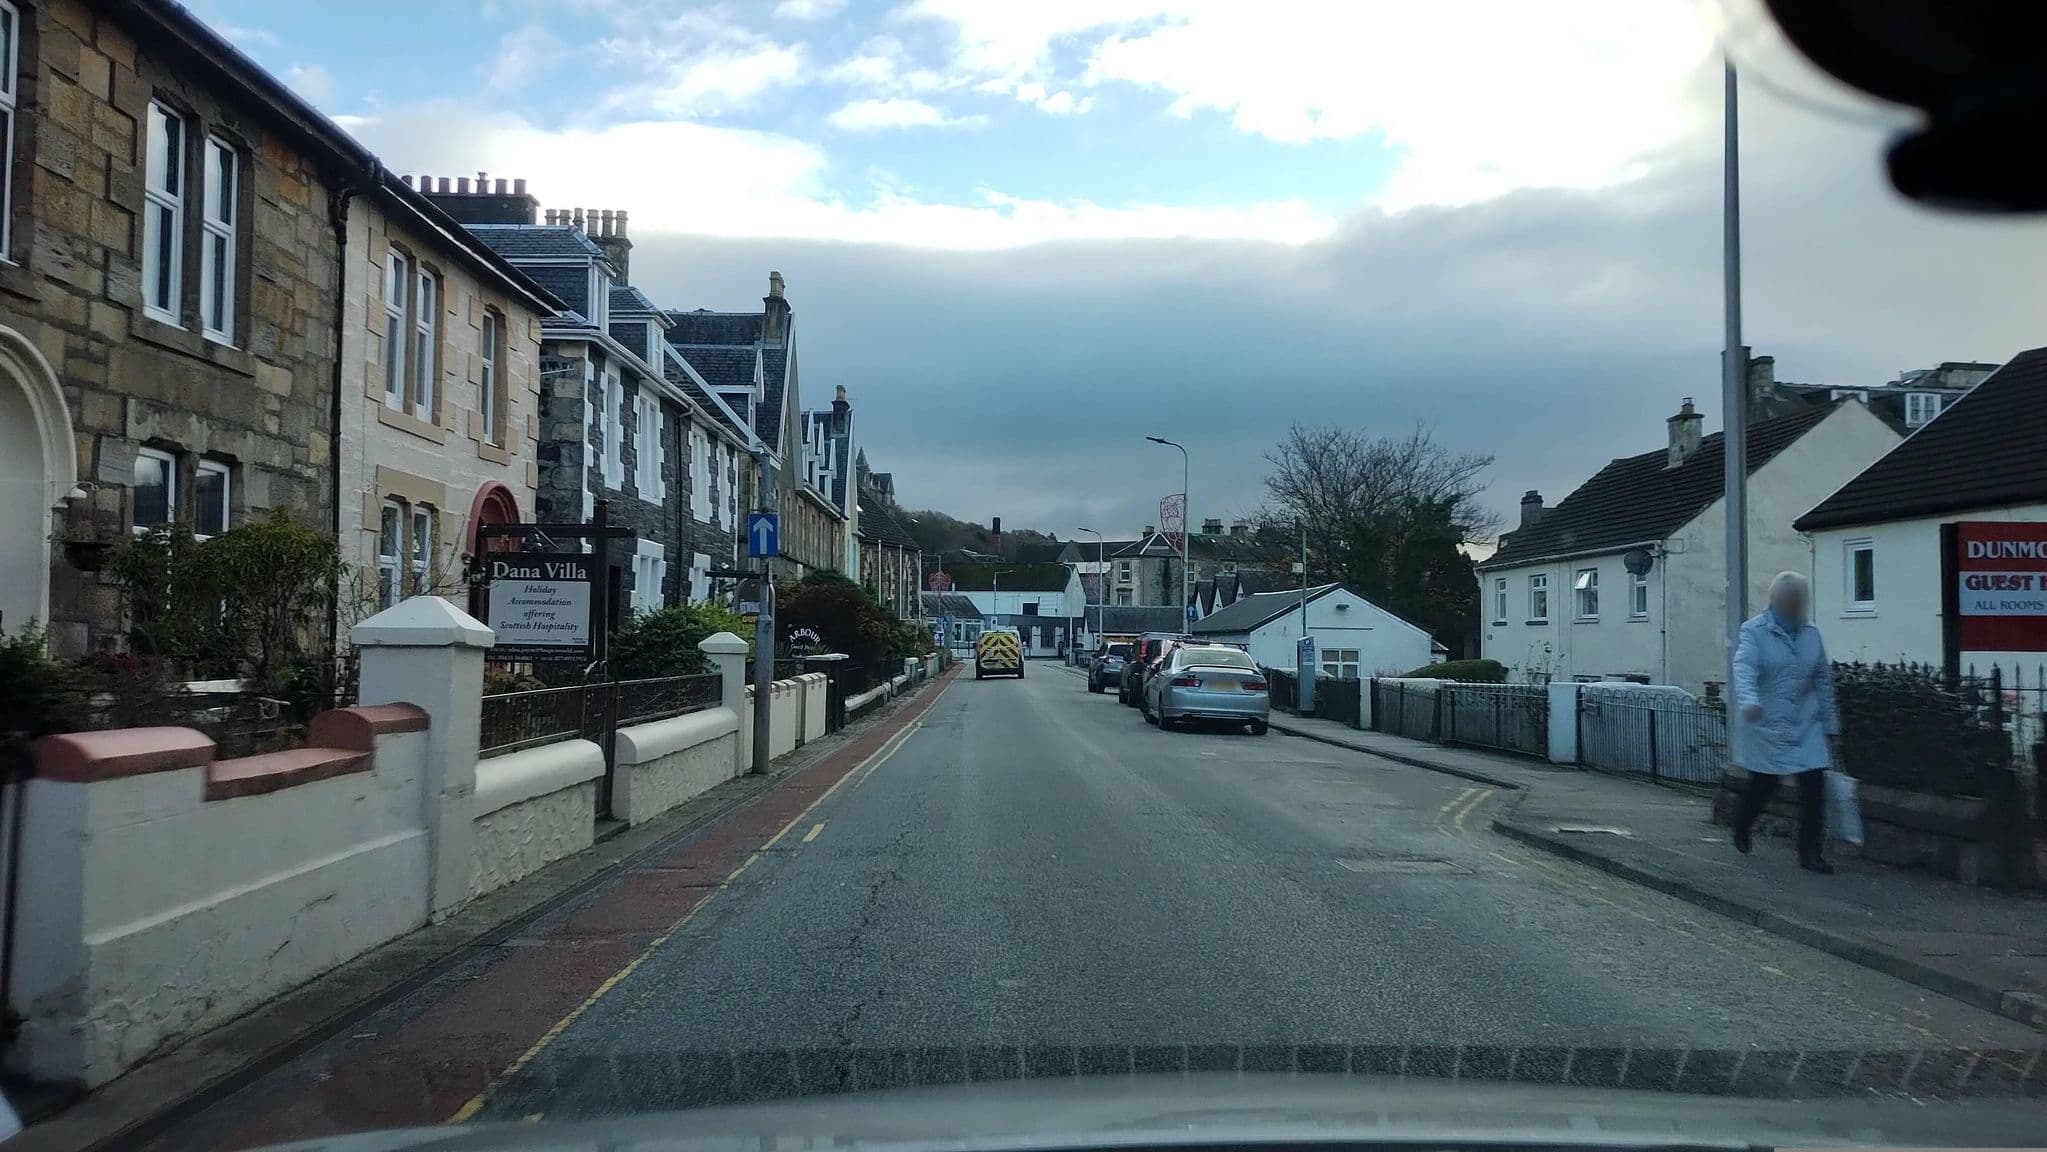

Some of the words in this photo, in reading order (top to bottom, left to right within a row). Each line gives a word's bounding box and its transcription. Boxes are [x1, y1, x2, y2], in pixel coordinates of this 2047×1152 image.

[492, 561, 541, 579] Dana
[545, 562, 587, 579] Villa
[1965, 575, 2035, 592] GUEST
[523, 585, 557, 596] Holiday
[507, 597, 572, 606] Accommodation
[1974, 600, 1998, 610] ALL
[2000, 600, 2045, 611] ROOMS
[523, 609, 556, 620] offering
[500, 621, 531, 630] Scottish
[533, 621, 579, 633] Hospitality
[788, 628, 821, 645] ARBOUR
